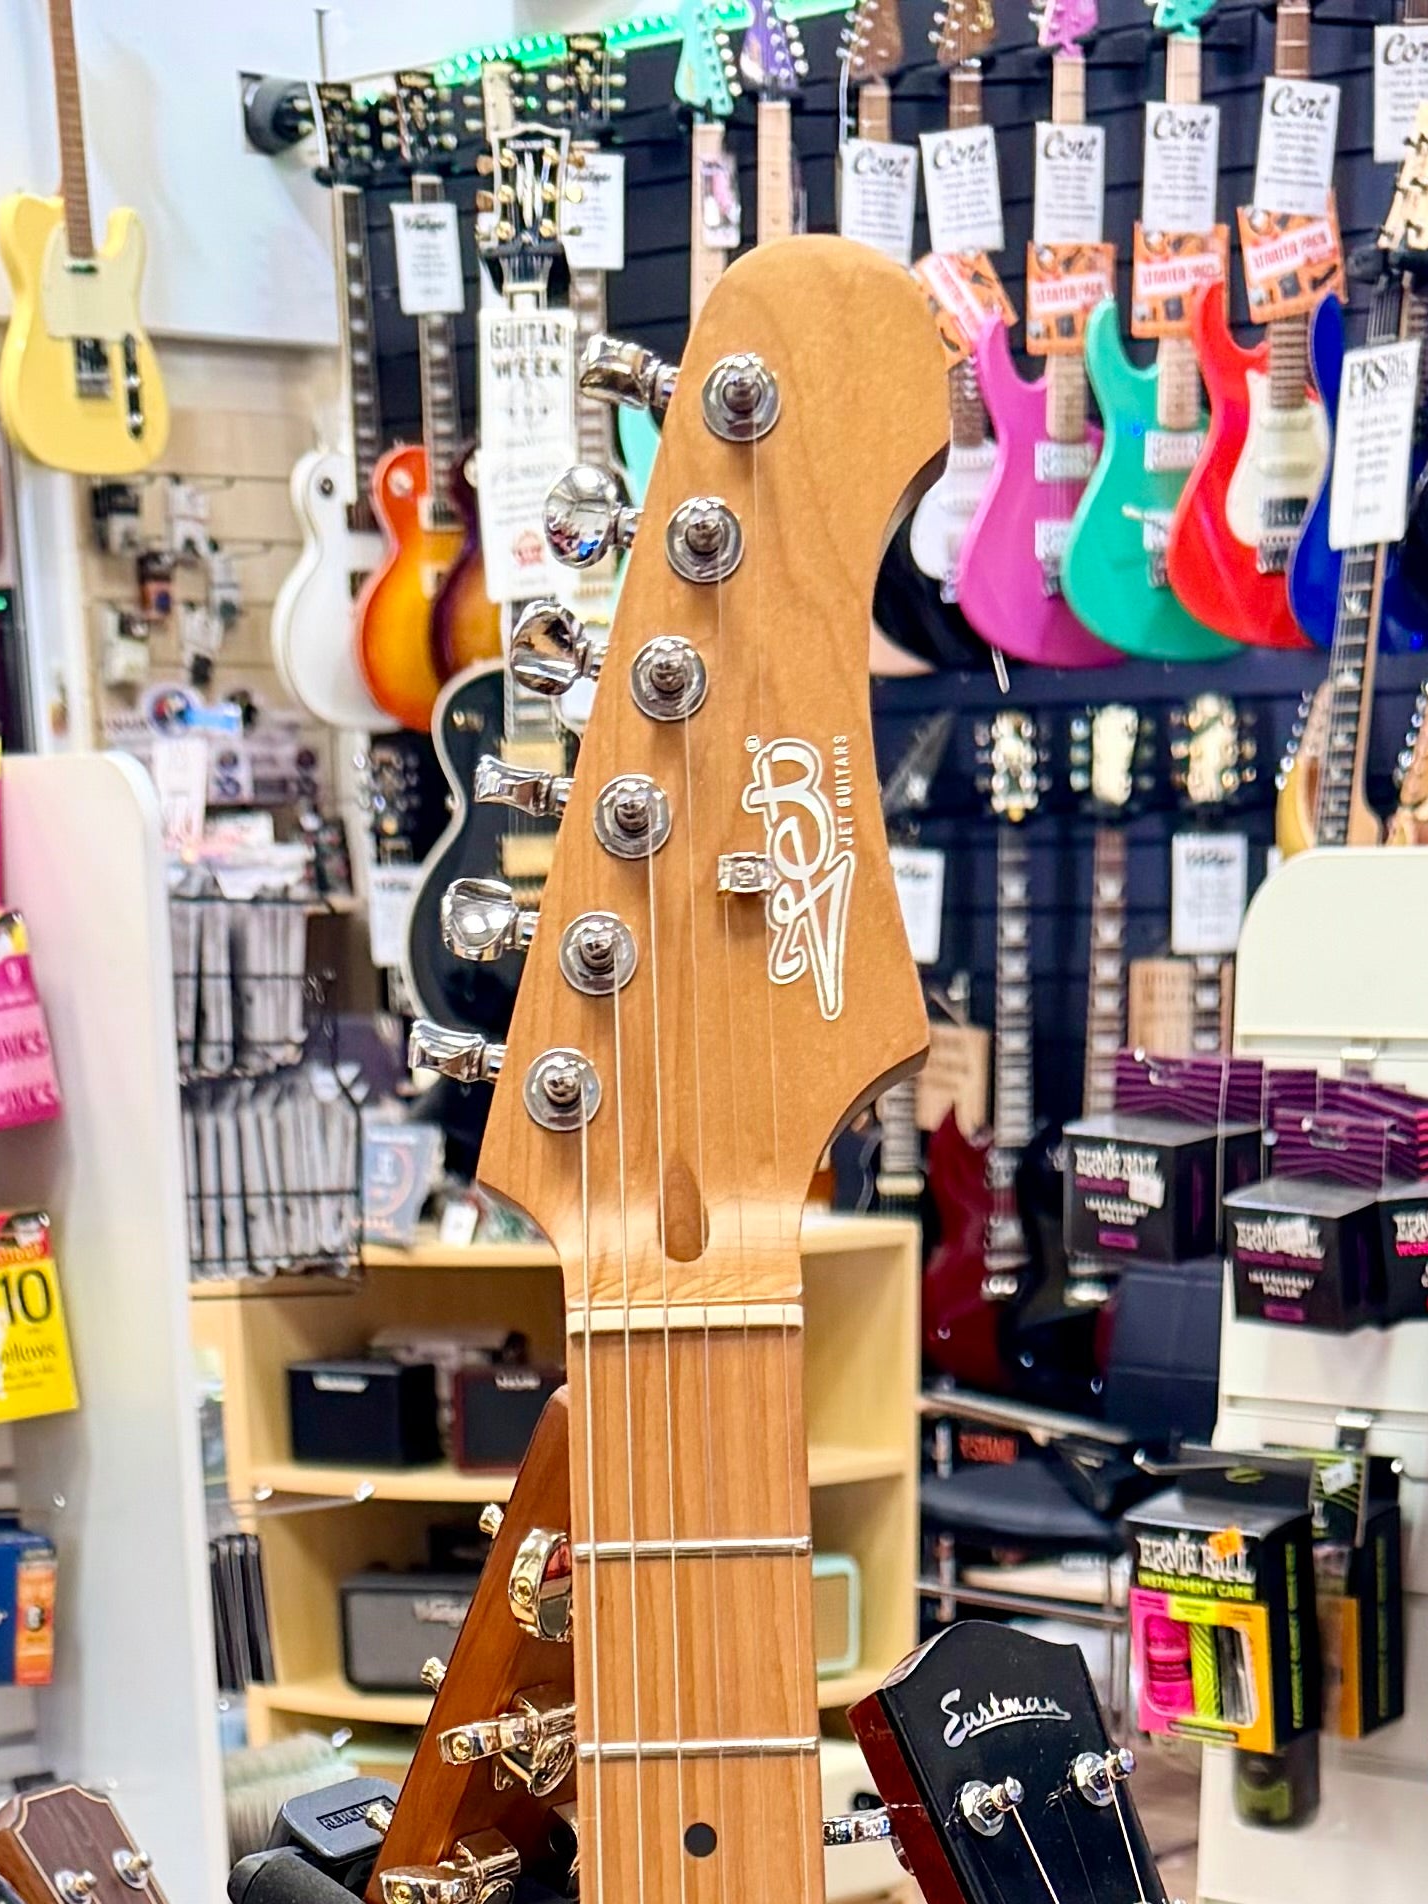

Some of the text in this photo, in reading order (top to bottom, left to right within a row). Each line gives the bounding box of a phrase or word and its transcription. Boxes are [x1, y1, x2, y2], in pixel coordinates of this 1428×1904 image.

[1270, 86, 1331, 122] Cort
[1153, 110, 1212, 142] Cort
[489, 317, 568, 349] GUITAR
[491, 357, 563, 380] WEEK
[832, 733, 855, 848] JET GUITARS
[0, 1269, 52, 1325] 10
[942, 1689, 1071, 1748] Eastman
